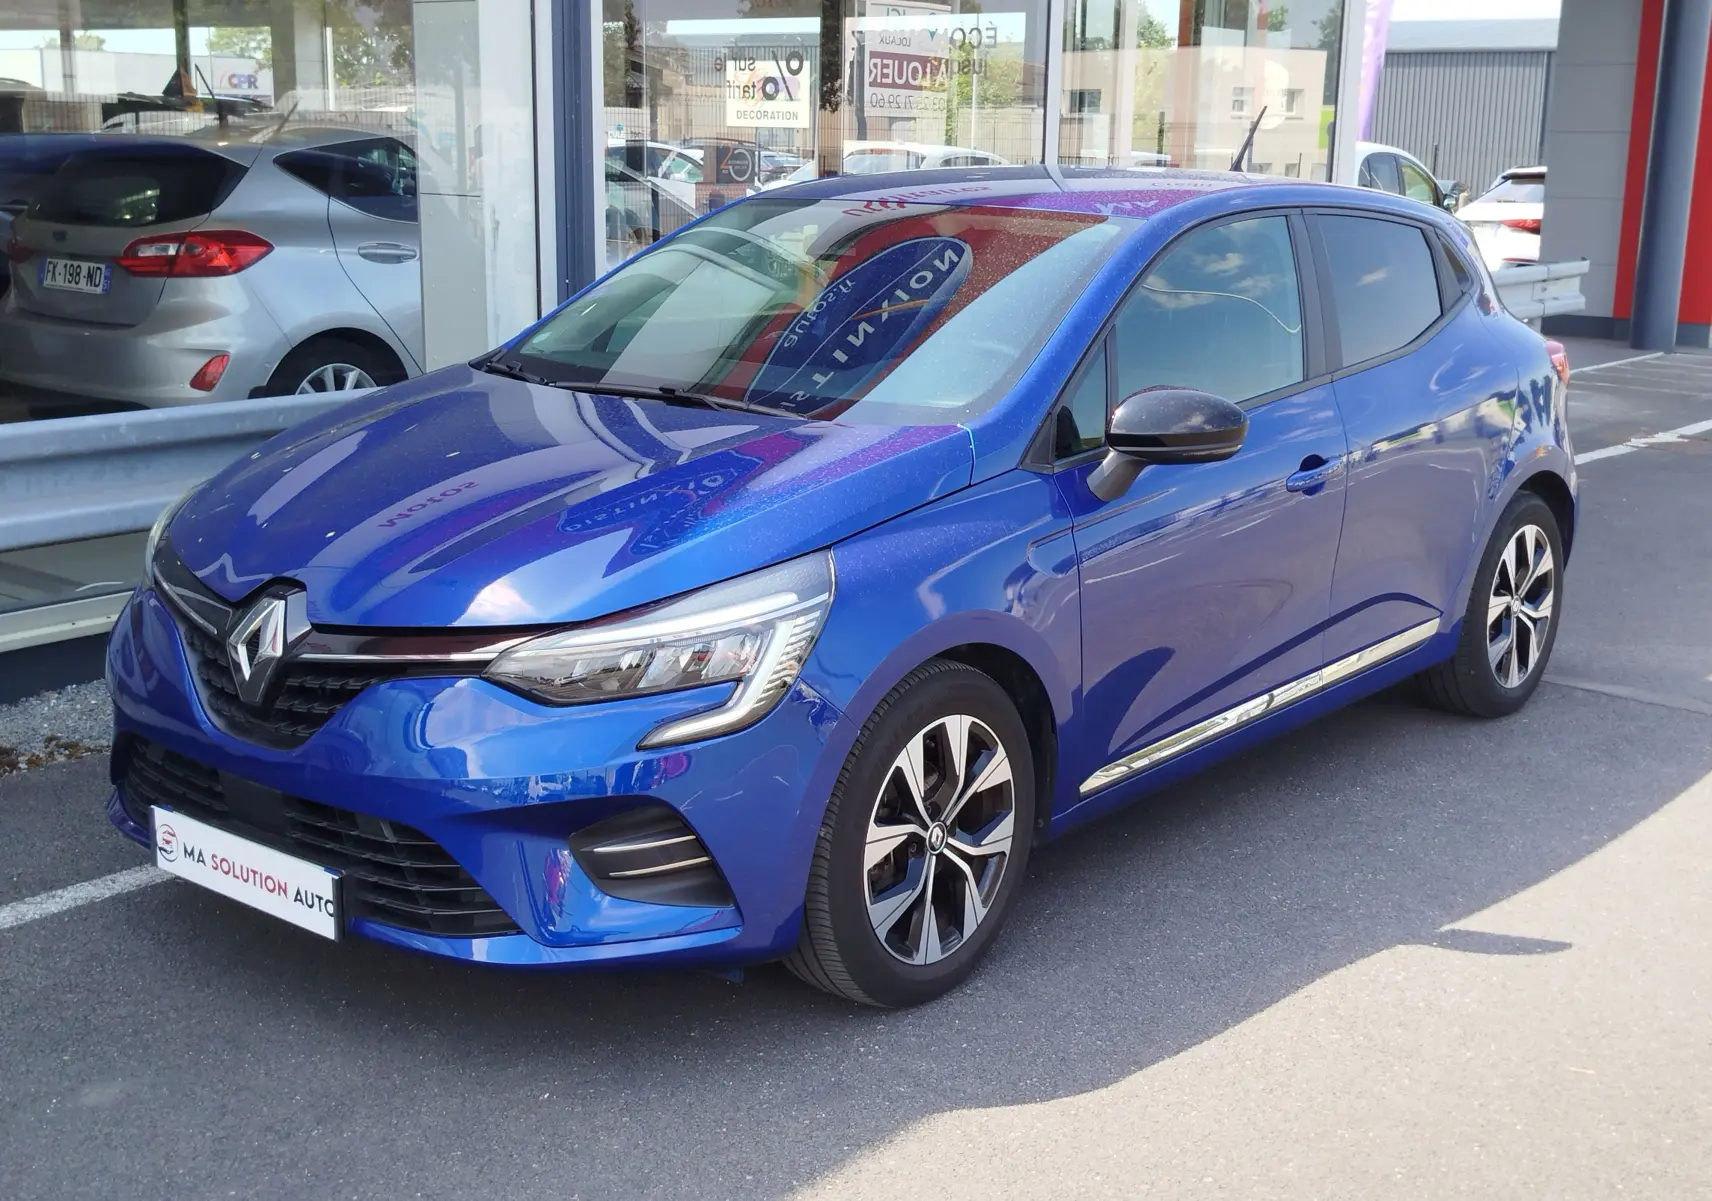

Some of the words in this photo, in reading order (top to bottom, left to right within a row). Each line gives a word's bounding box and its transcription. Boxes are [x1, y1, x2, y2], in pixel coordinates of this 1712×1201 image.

[227, 73, 258, 89] CPR
[736, 110, 799, 121] DECORATION
[183, 841, 206, 867] MA
[211, 853, 288, 899] SOLUTION
[293, 886, 335, 918] AUTO
